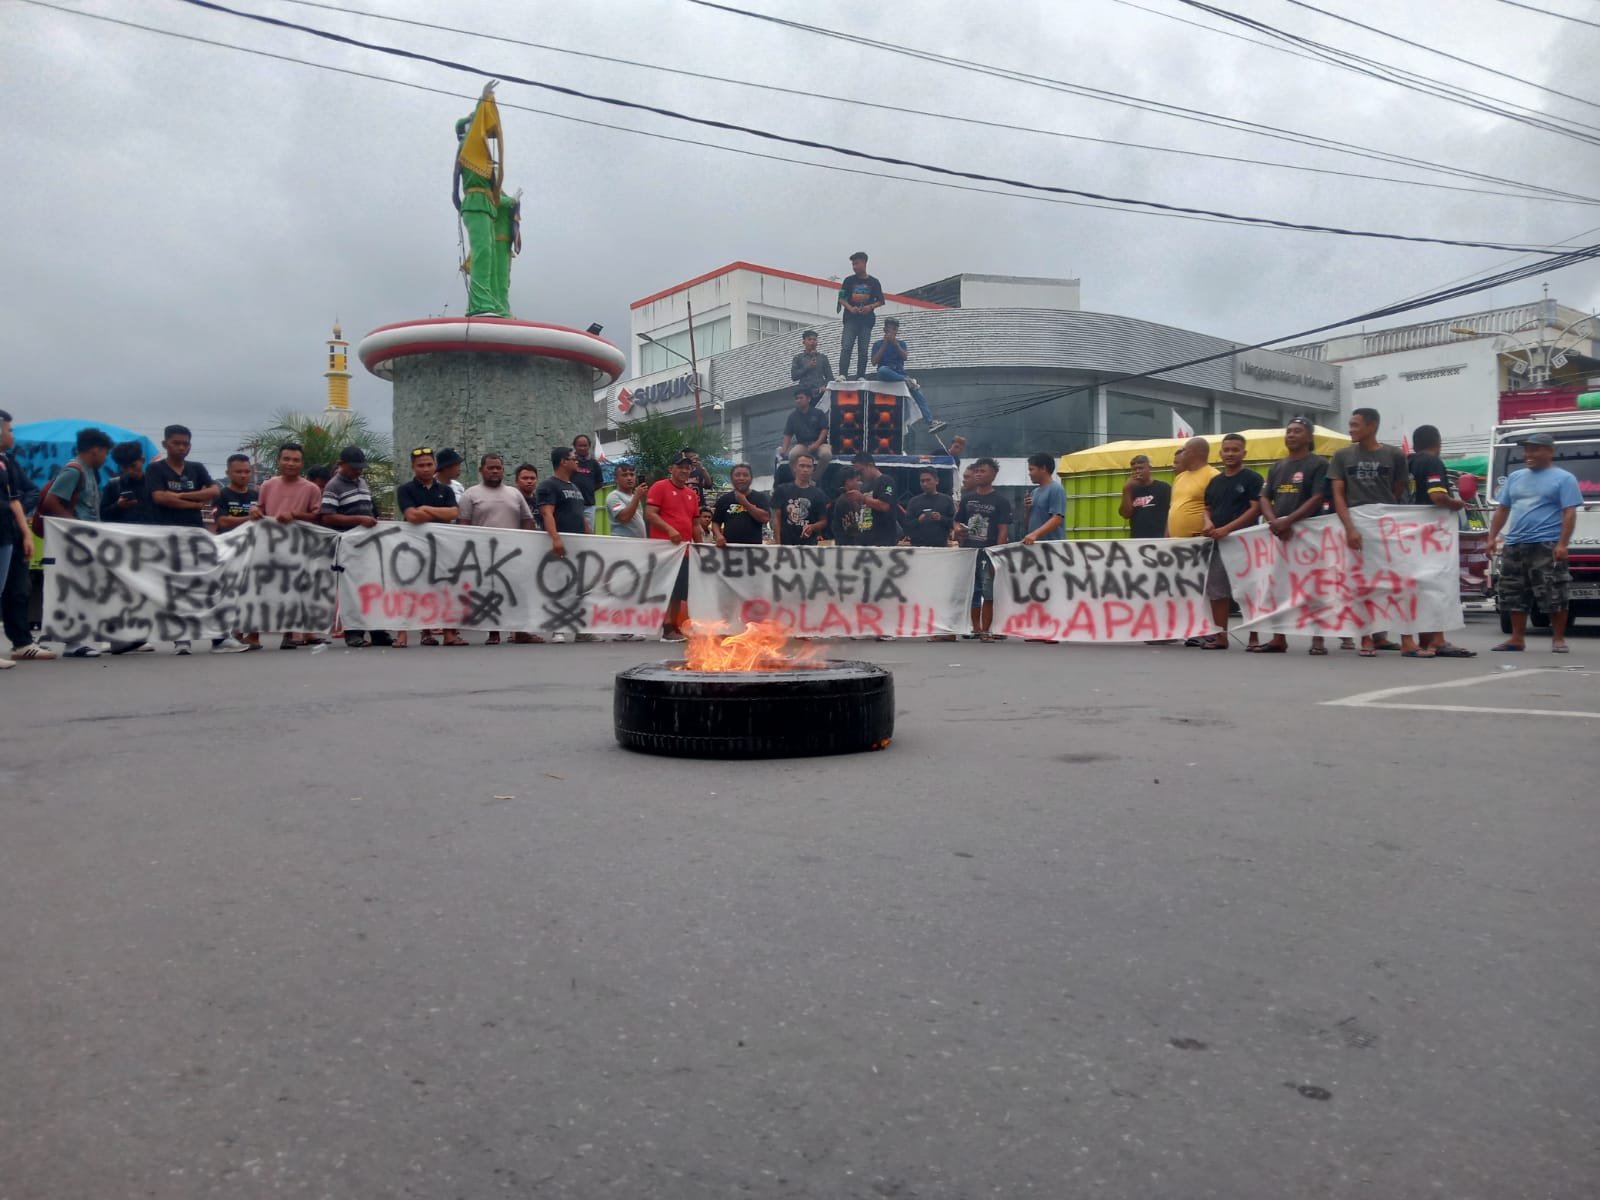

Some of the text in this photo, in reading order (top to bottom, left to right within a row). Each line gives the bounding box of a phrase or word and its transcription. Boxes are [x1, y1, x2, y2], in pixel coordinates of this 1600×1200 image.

[355, 526, 667, 607] TOLAK ODOL
[698, 545, 915, 578] BERANTAS
[992, 541, 1133, 574] TANPA
[771, 567, 908, 603] MAFIA
[1063, 569, 1206, 600] MAKAN
